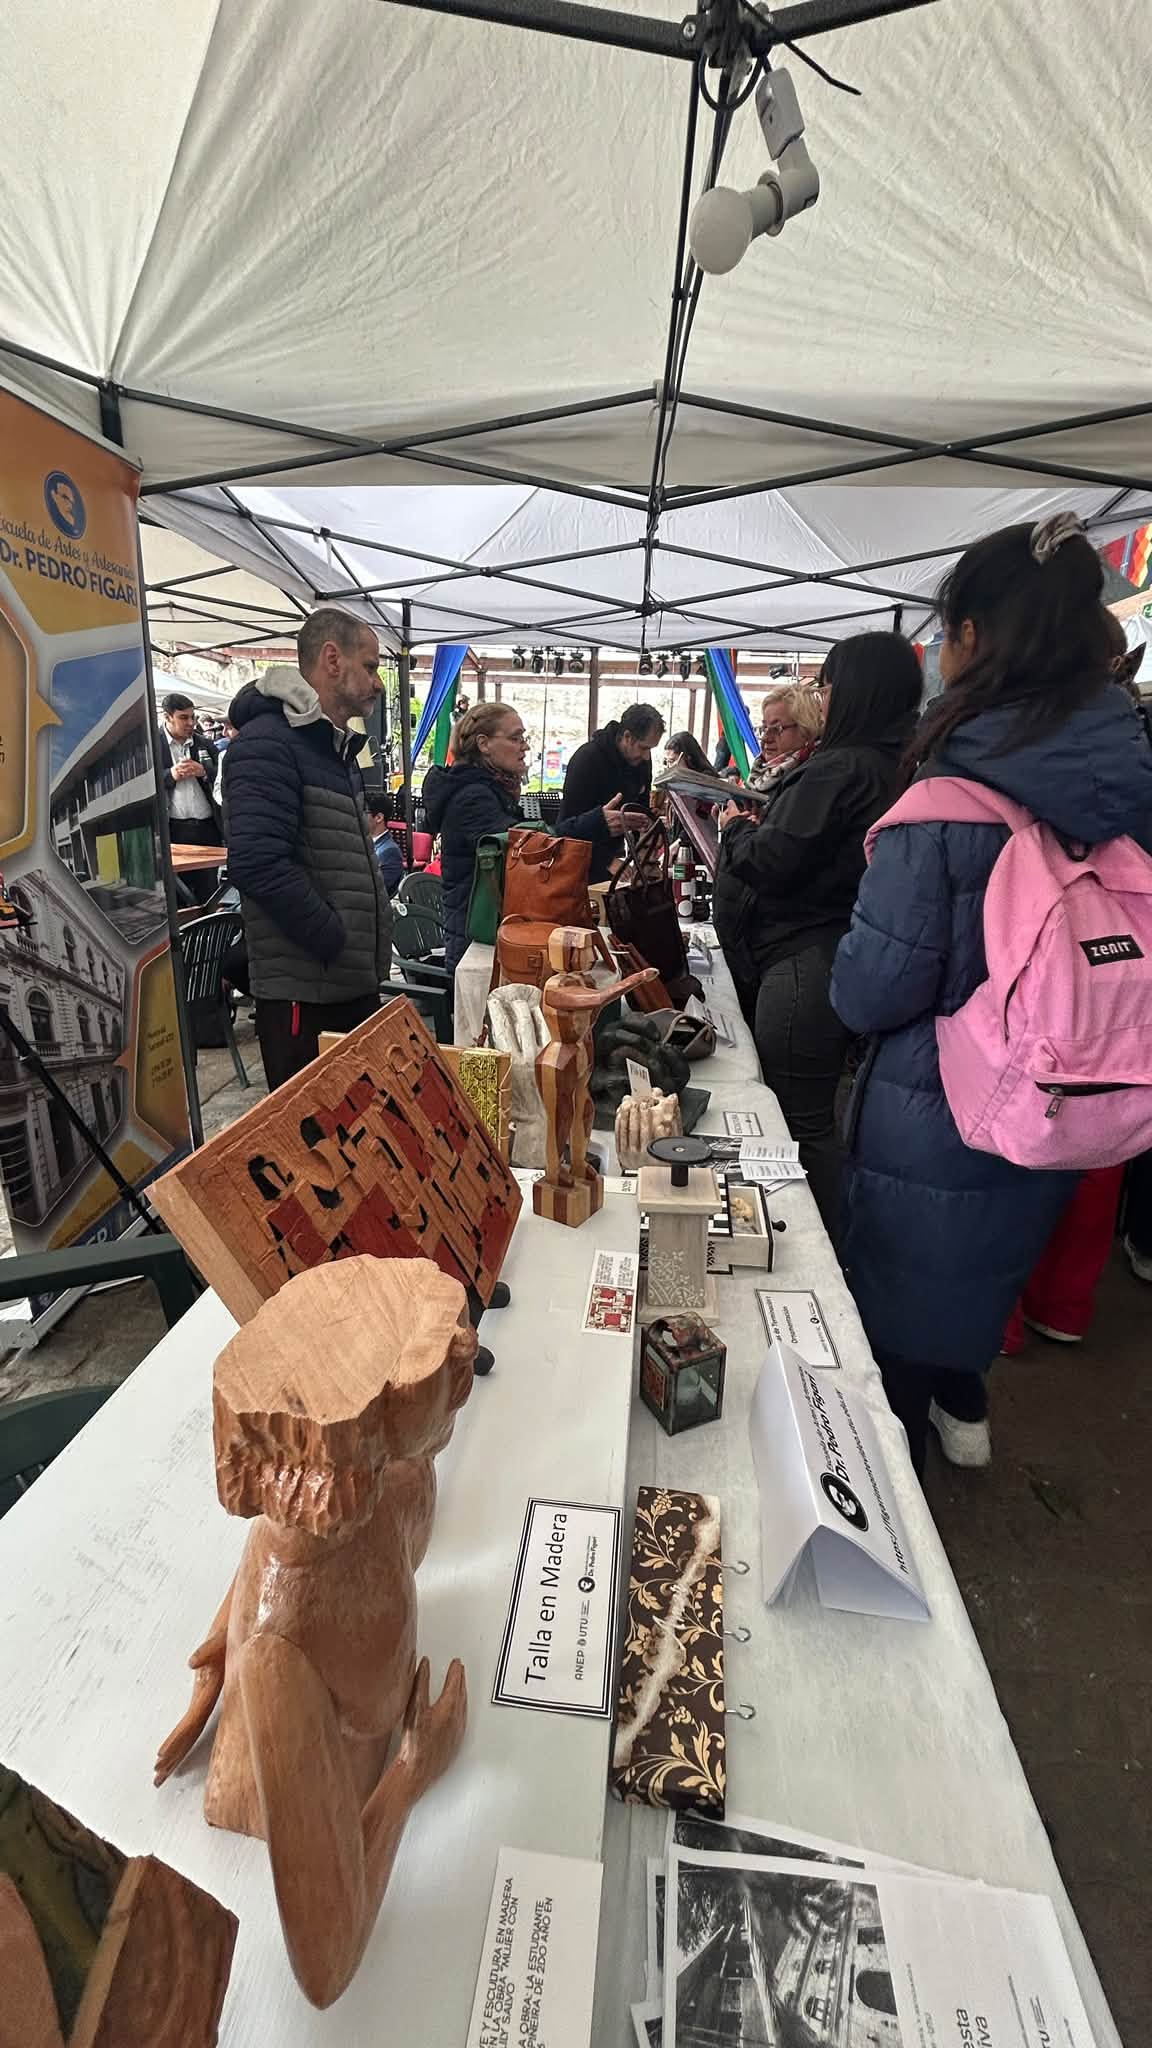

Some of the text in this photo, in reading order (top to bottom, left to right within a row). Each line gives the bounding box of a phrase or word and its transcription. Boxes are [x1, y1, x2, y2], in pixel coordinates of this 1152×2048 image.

[0, 519, 34, 542] scuela
[39, 528, 52, 549] de
[55, 536, 80, 559] Artes
[0, 538, 138, 608] Dr. PEDRO FIGARI
[805, 1370, 826, 1414] Figari
[821, 1414, 842, 1458] Pedro
[836, 1459, 850, 1483] Dr.
[525, 1513, 568, 1685] Talla en Madera
[579, 1617, 589, 1637] UTU
[575, 1650, 585, 1681] ANEP
[500, 1878, 513, 1926] MADERA
[508, 1897, 519, 1925] CON
[544, 1897, 553, 1913] EN
[496, 1928, 505, 1944] EN
[528, 1899, 544, 1970] ESTUDIANTE
[537, 1945, 548, 1974] 2DO
[484, 1947, 502, 2018] ESCULTURA
[495, 1976, 507, 2012] OBRA
[526, 1974, 534, 1989] LA
[534, 1977, 544, 1995] DE
[502, 1983, 515, 2024] SALVO
[482, 2021, 490, 2032] Y
[492, 2016, 501, 2032] LA
